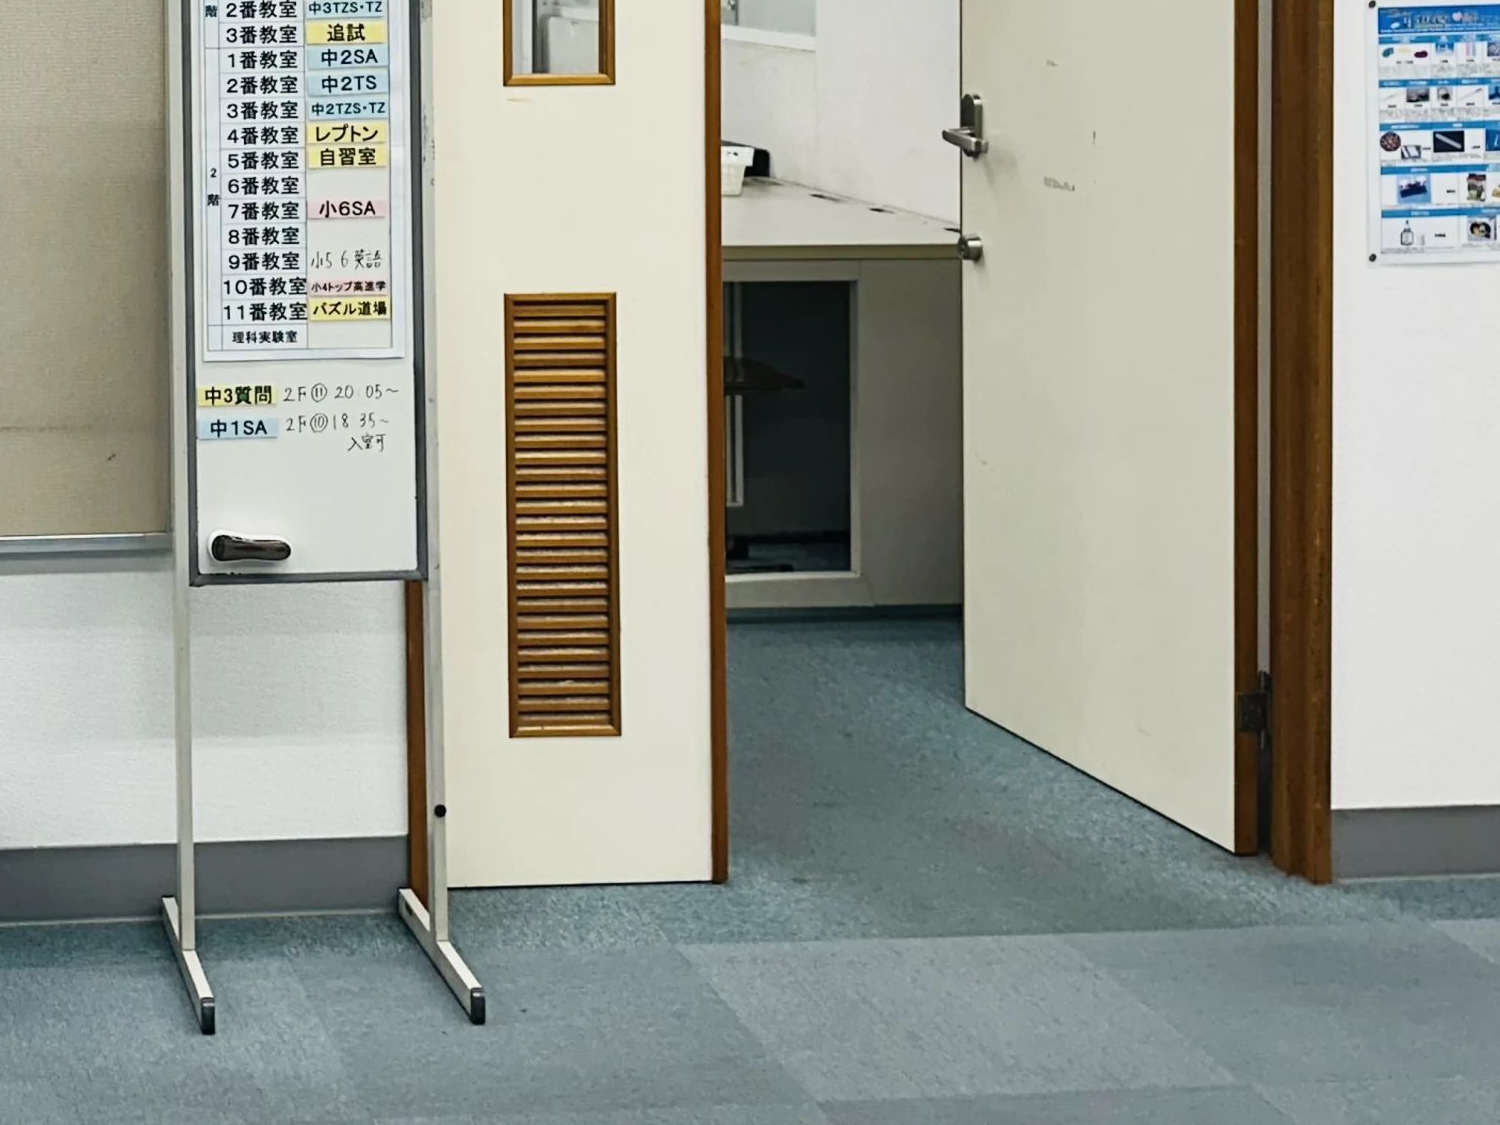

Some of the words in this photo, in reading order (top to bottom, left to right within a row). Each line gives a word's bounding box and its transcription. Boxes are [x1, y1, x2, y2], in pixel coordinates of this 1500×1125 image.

[226, 0, 298, 19] 2番教室
[226, 25, 298, 44] 3番教室
[327, 24, 365, 42] 追試
[228, 50, 298, 69] 1番教室
[321, 49, 378, 67] 中2SA
[226, 76, 298, 94] 2番教室
[322, 75, 377, 93] 中2TS
[227, 101, 299, 120] 3番教室
[227, 126, 299, 145] 4番教室
[315, 124, 378, 142] レプトン
[228, 151, 299, 170] 5番教室
[320, 148, 376, 166] 自習室
[228, 176, 299, 195] 6番教室
[228, 201, 300, 220] 7番教室
[319, 201, 376, 218] 小6SA
[228, 227, 300, 245] 8番教室
[229, 251, 300, 270] 9番教室
[224, 277, 307, 296] 10番教室
[224, 302, 307, 321] 11番教室
[232, 331, 298, 343] 理科実験室
[205, 386, 272, 405] 中3質問
[211, 420, 267, 437] 中1SA
